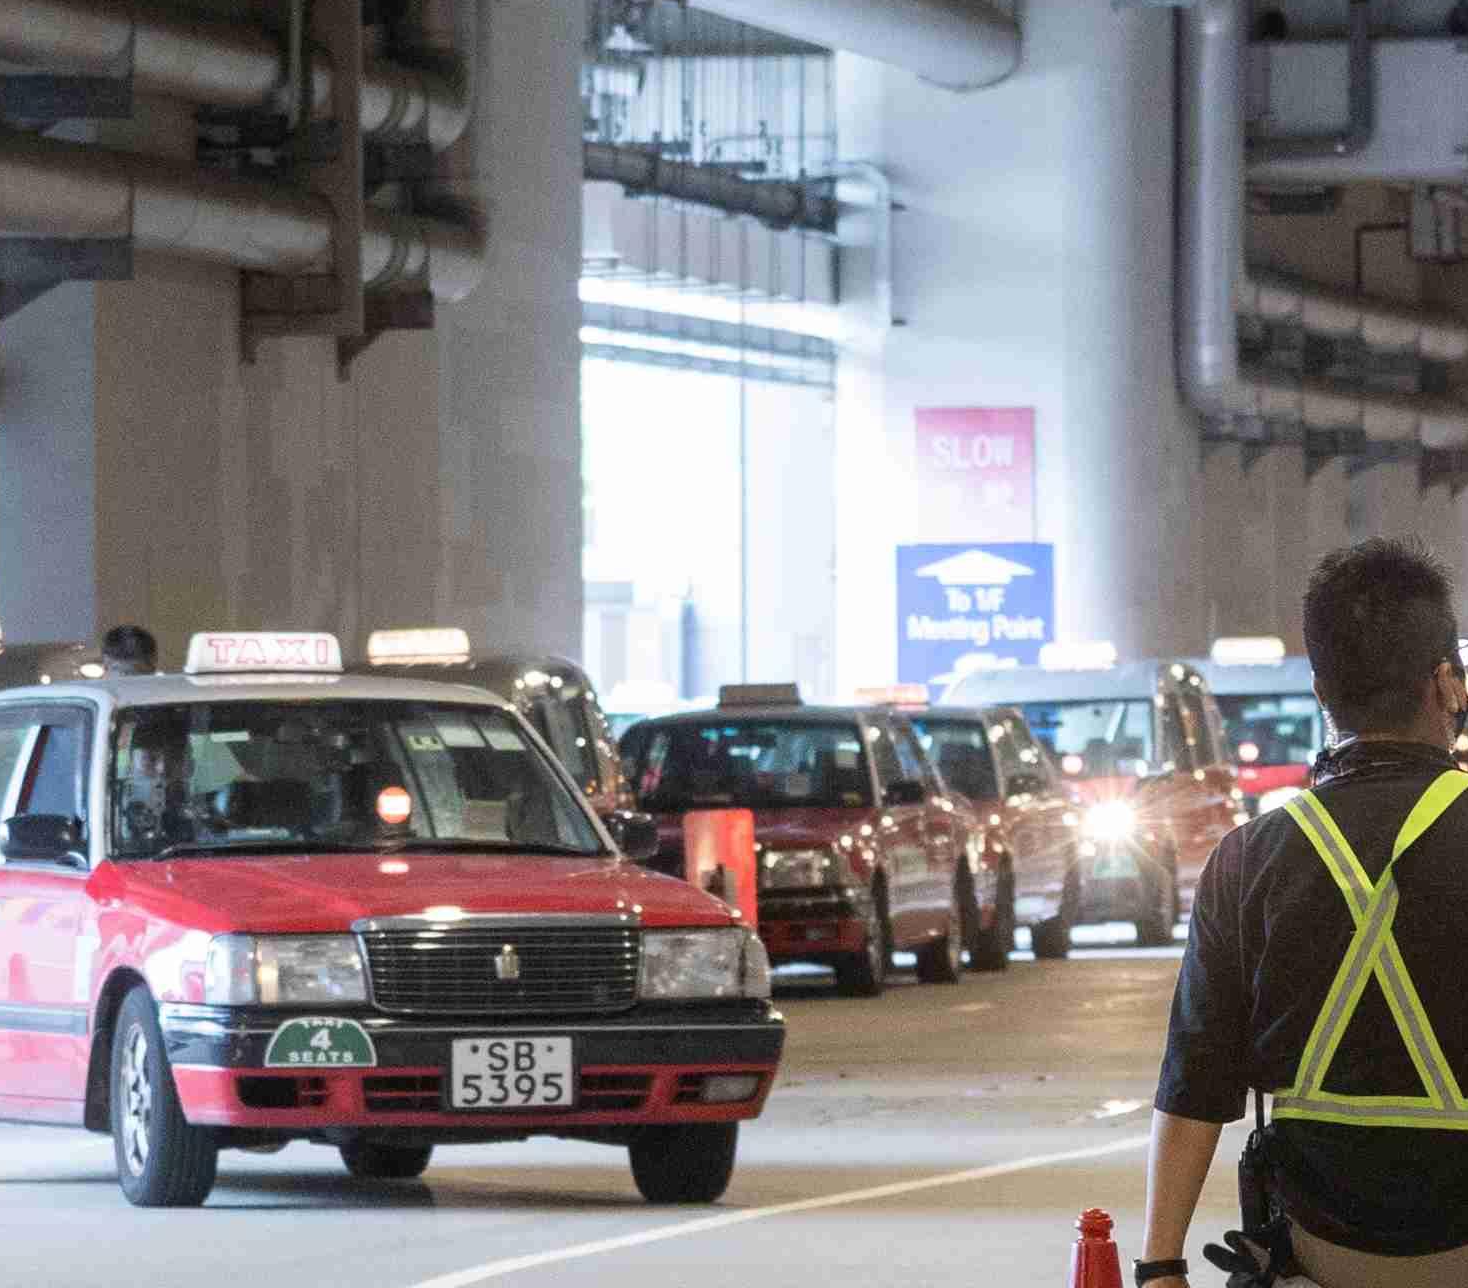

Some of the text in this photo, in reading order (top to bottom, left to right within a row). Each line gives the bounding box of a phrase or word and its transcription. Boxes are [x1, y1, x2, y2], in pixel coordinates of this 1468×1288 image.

[932, 435, 1014, 468] SLOW
[208, 637, 329, 665] TAXI
[310, 1028, 332, 1049] 4
[288, 1051, 354, 1063] SEATS
[487, 1041, 535, 1071] SB
[461, 1073, 563, 1105] 5395
